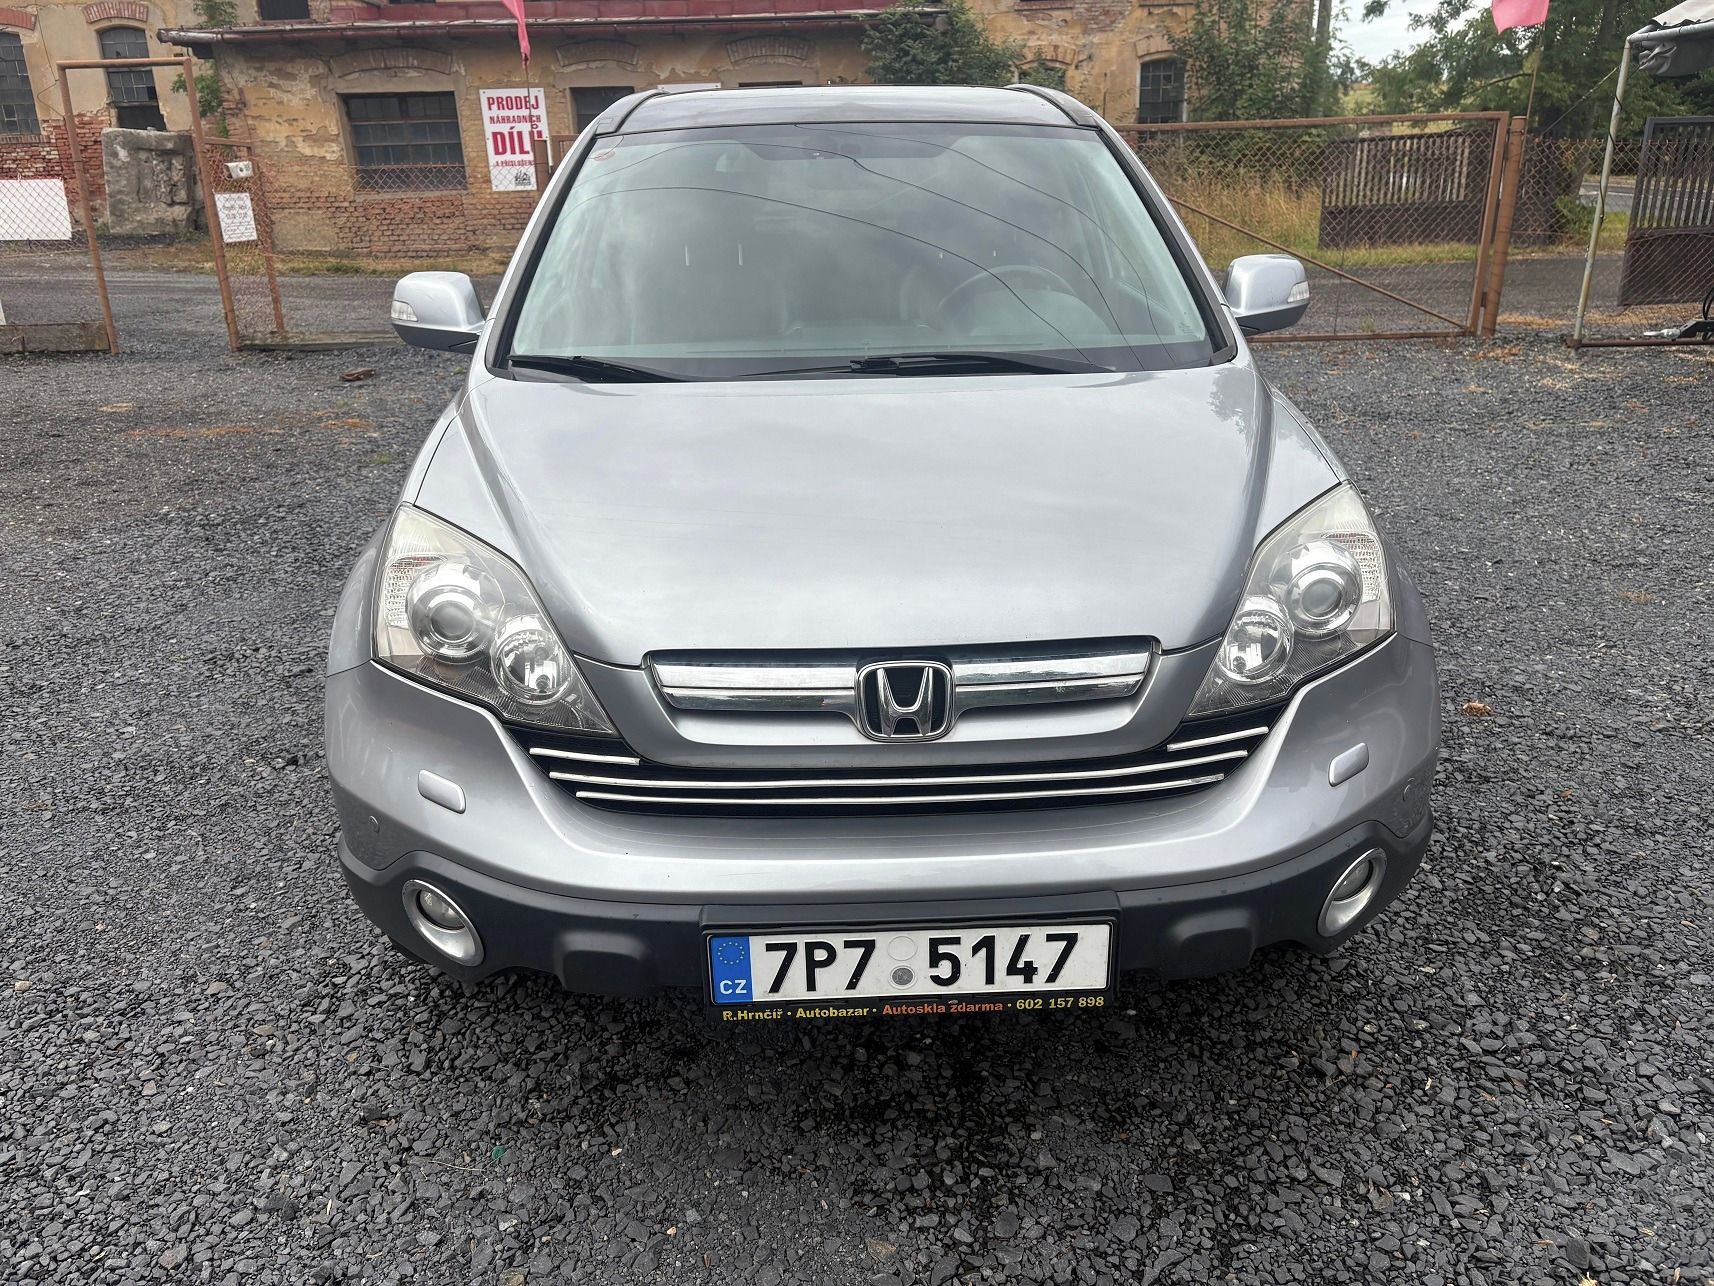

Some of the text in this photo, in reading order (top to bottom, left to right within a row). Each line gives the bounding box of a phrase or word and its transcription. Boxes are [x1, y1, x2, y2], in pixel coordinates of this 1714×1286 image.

[487, 95, 540, 111] PRODEJ
[719, 932, 1079, 995] CZ 7P7 5147
[722, 996, 1105, 1021] R.Hrnčíř Autobazar Autoskla zdarma 602 157 898
